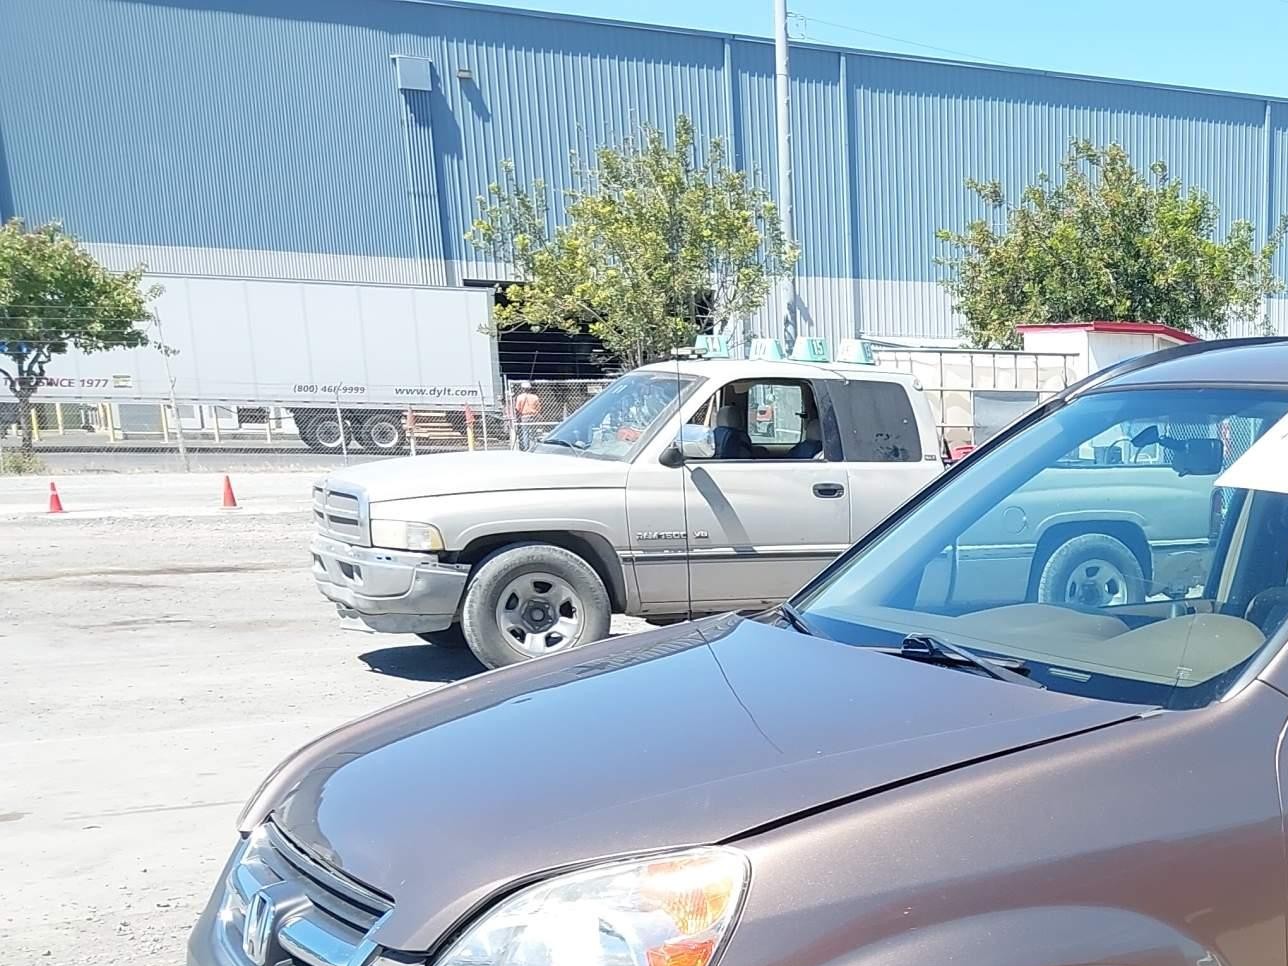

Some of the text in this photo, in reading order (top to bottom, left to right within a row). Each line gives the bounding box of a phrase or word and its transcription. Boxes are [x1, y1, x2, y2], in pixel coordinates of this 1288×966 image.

[38, 377, 76, 388] SINCE
[79, 378, 109, 388] 1977
[293, 384, 319, 394] (800)
[394, 386, 479, 398] www.dylt.com
